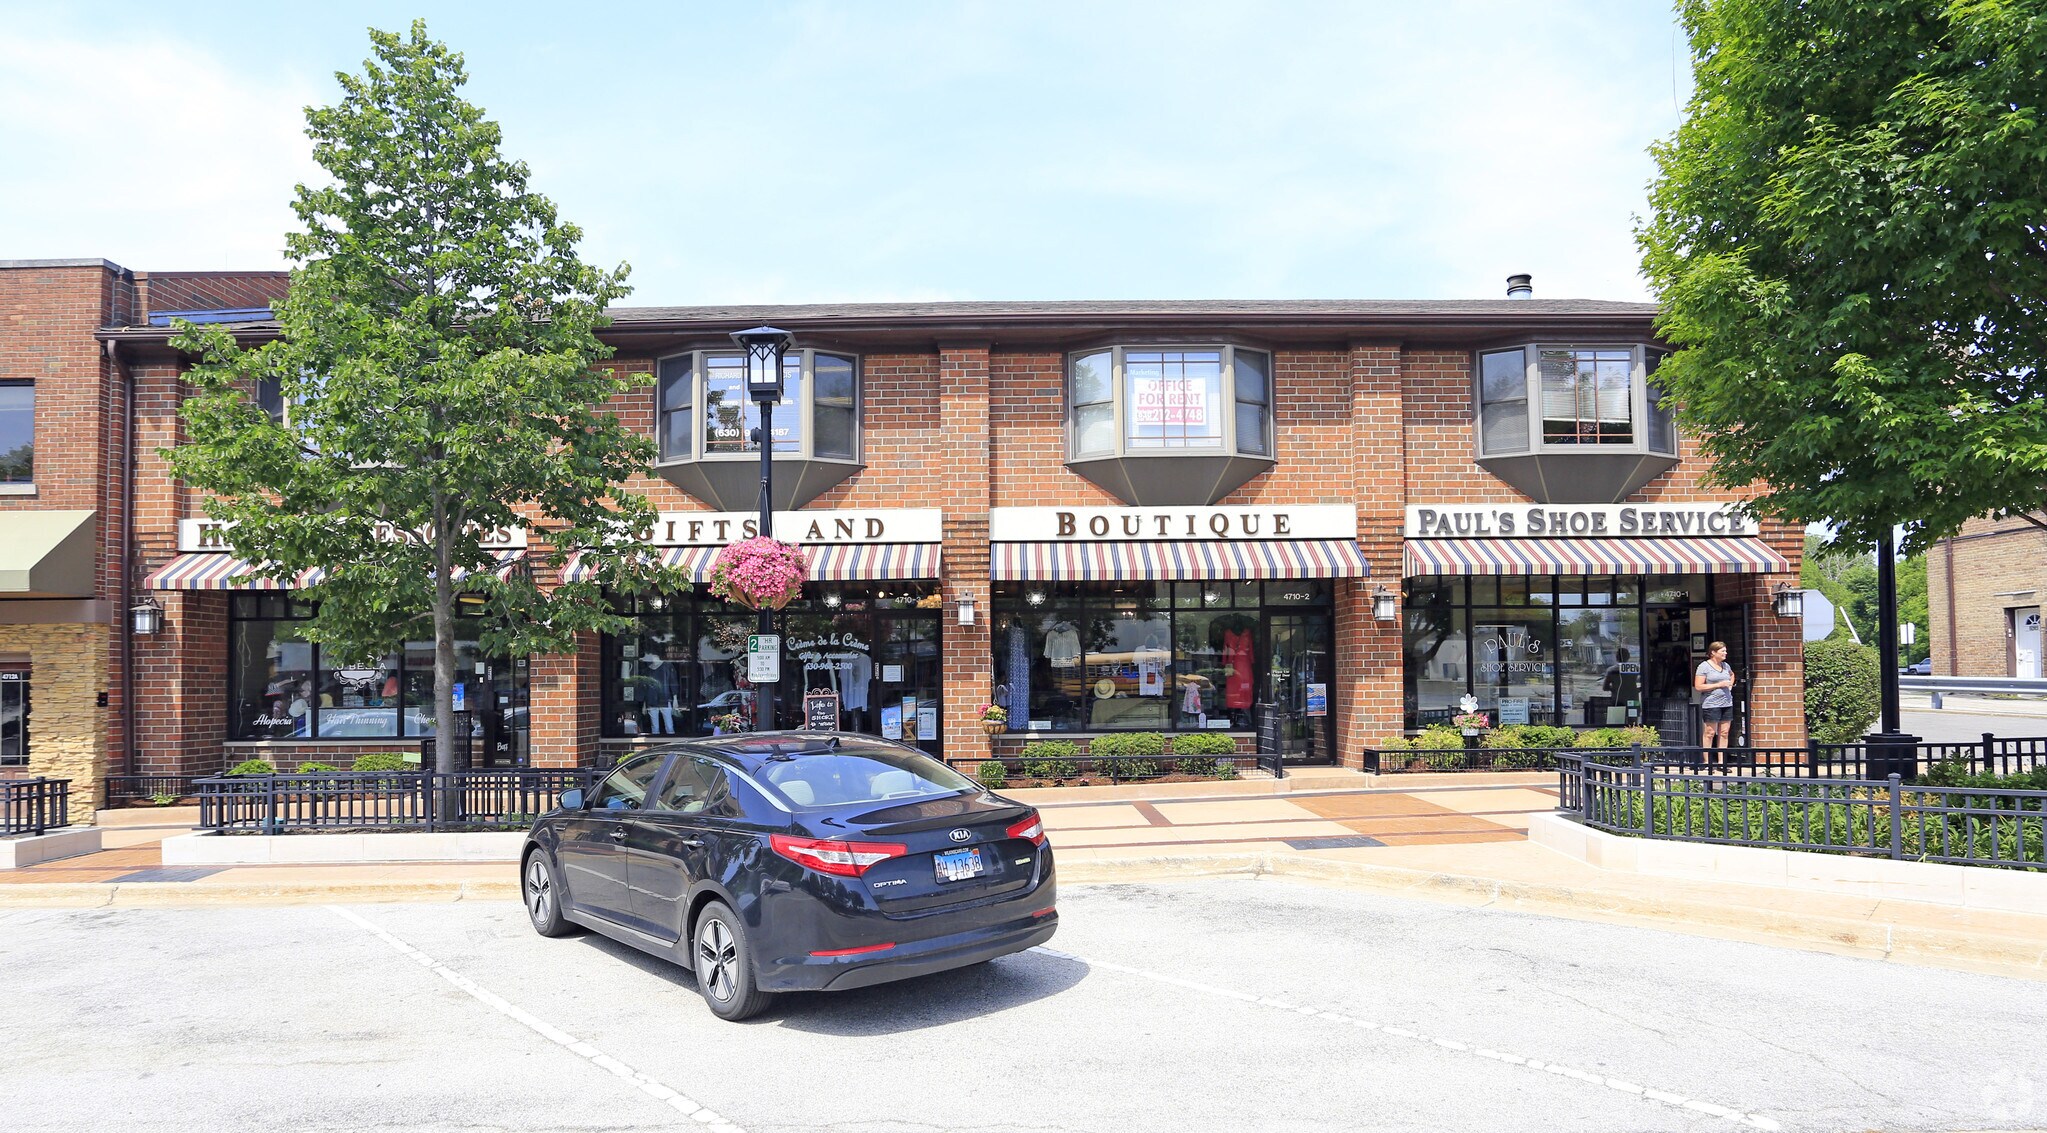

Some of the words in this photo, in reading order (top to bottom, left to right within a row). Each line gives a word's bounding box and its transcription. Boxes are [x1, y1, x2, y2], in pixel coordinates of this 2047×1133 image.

[1148, 380, 1192, 391] OFFICE
[1139, 393, 1164, 405] FOR
[1169, 393, 1201, 405] RENT
[714, 428, 740, 438] (630)
[1056, 512, 1290, 537] BOUTIQUE
[1418, 509, 1515, 534] PAUL'S
[1527, 508, 1608, 534] SHOE
[1619, 508, 1746, 534] SERVICE
[632, 519, 758, 542] GIFTS
[806, 518, 885, 540] AND
[750, 638, 758, 651] 2
[818, 635, 828, 646] de
[830, 633, 840, 646] la
[1484, 632, 1541, 654] PAUL'S
[1481, 662, 1505, 672] SHOE
[1508, 662, 1546, 672] SERVICE
[1620, 663, 1640, 672] OPEN
[253, 713, 293, 728] Alopecia
[952, 830, 970, 841] KIA
[873, 878, 908, 888] OPTIMA
